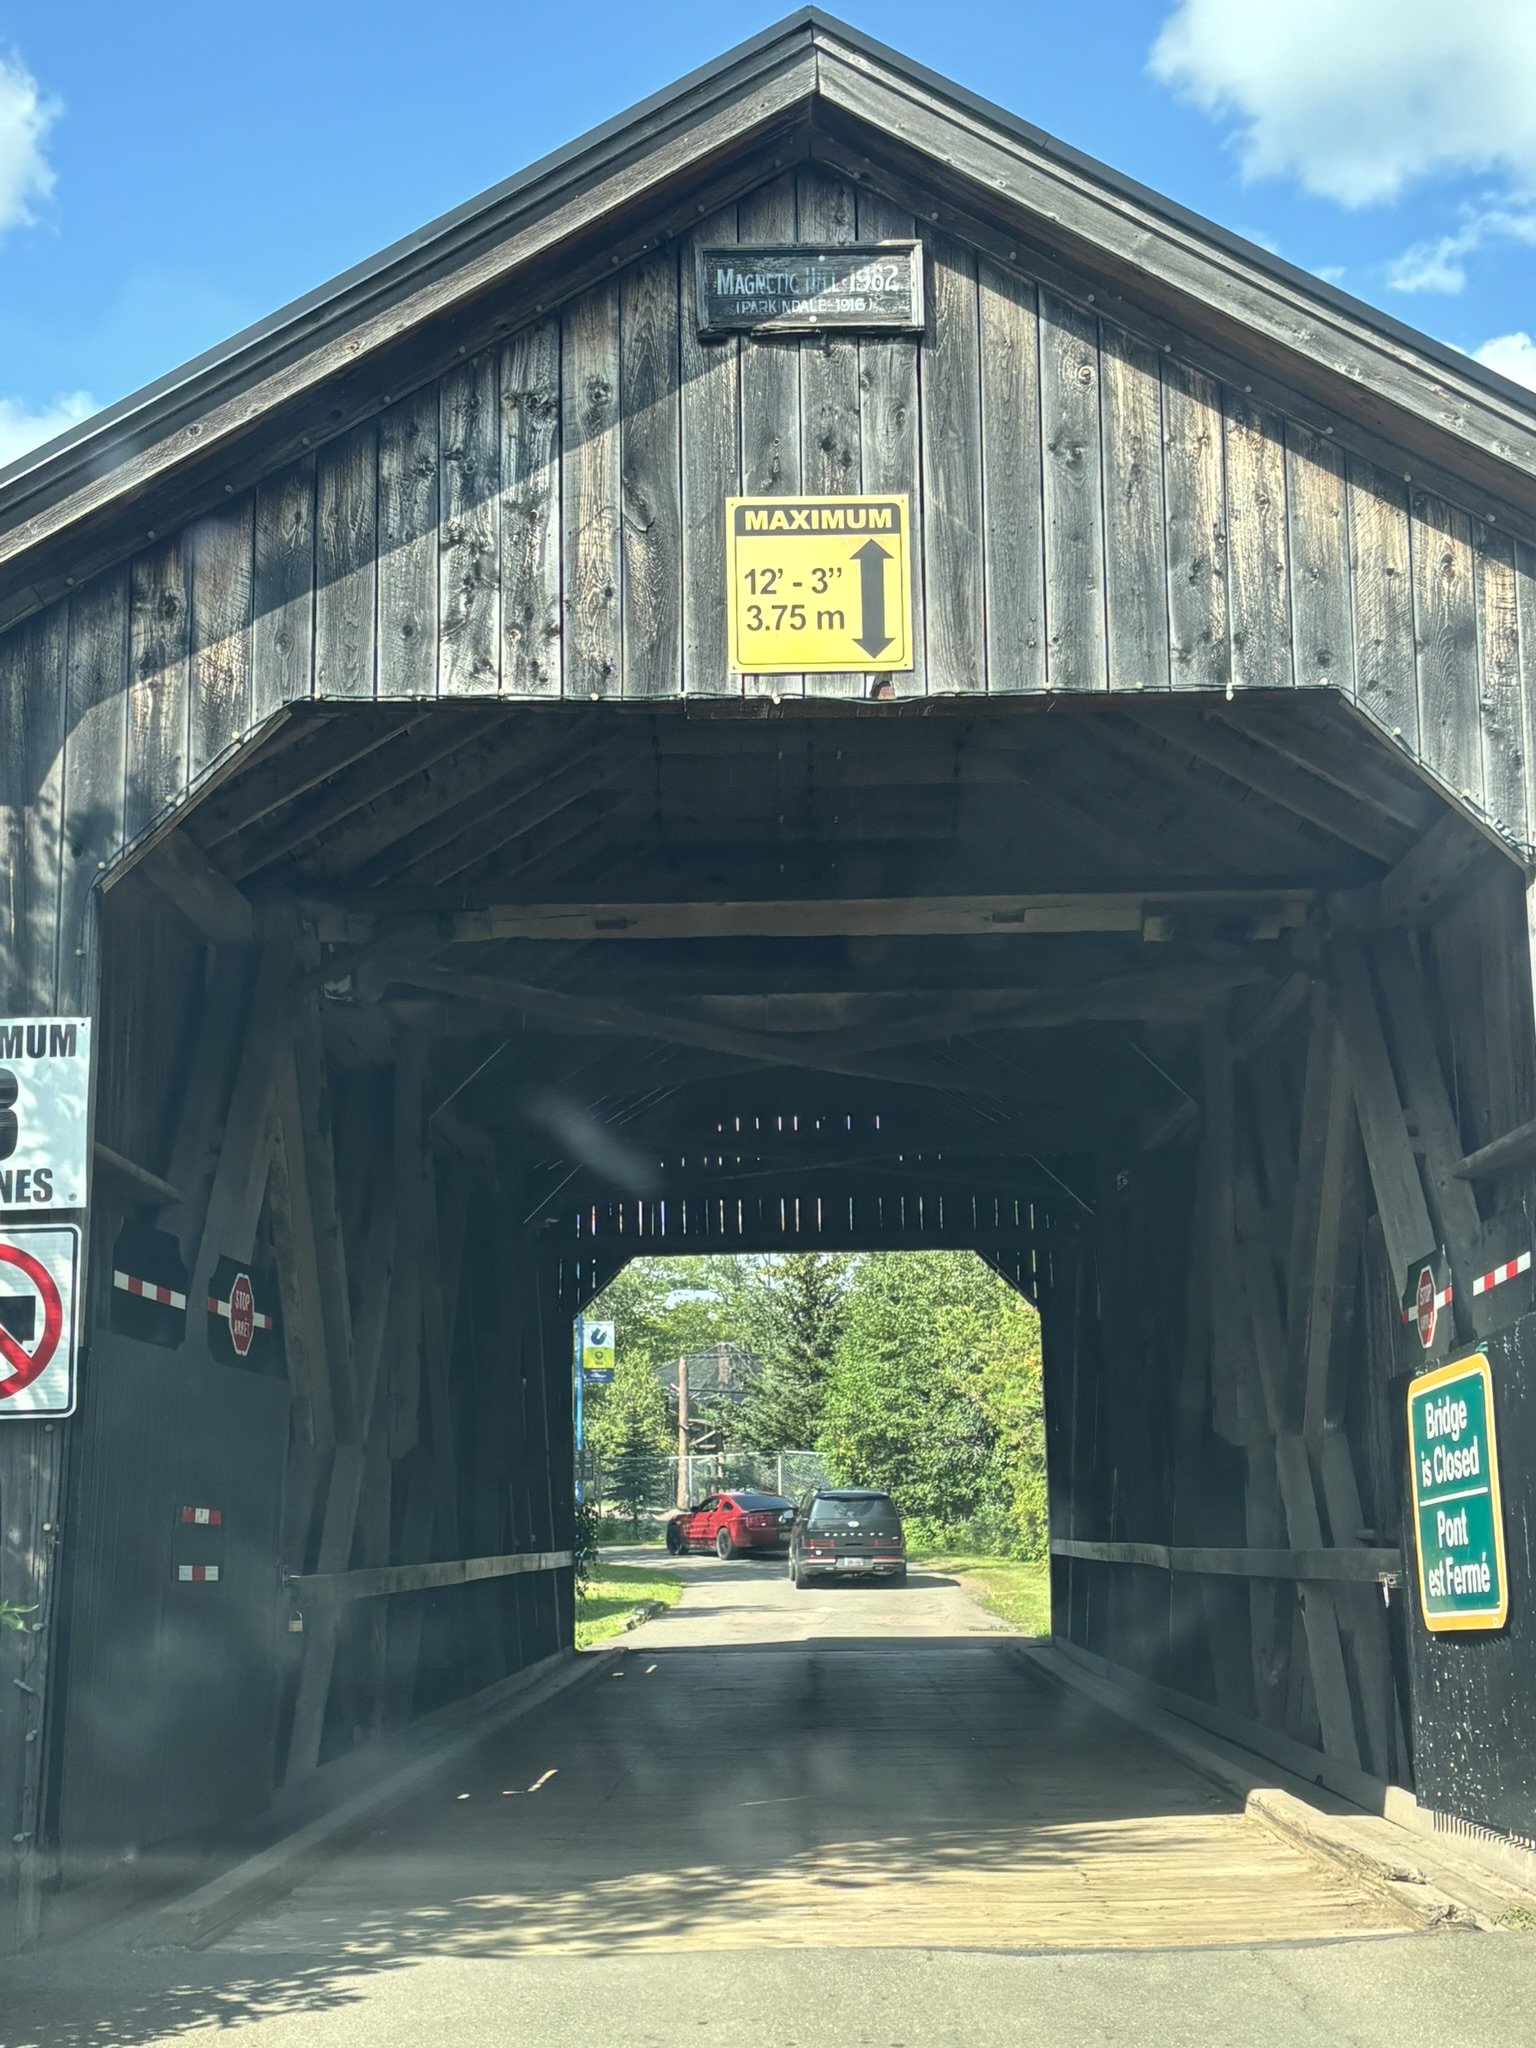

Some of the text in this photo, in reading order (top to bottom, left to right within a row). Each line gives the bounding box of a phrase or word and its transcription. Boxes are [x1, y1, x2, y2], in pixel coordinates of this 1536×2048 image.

[717, 267, 799, 295] MAGNETIC
[744, 508, 892, 531] MAXIMUM
[746, 604, 845, 631] 3.75 m
[235, 1290, 250, 1311] STOP
[1425, 1395, 1467, 1441] Bridge
[1421, 1435, 1479, 1488] is Closed
[1437, 1507, 1469, 1544] Pont
[1428, 1551, 1491, 1597] est Fermé
